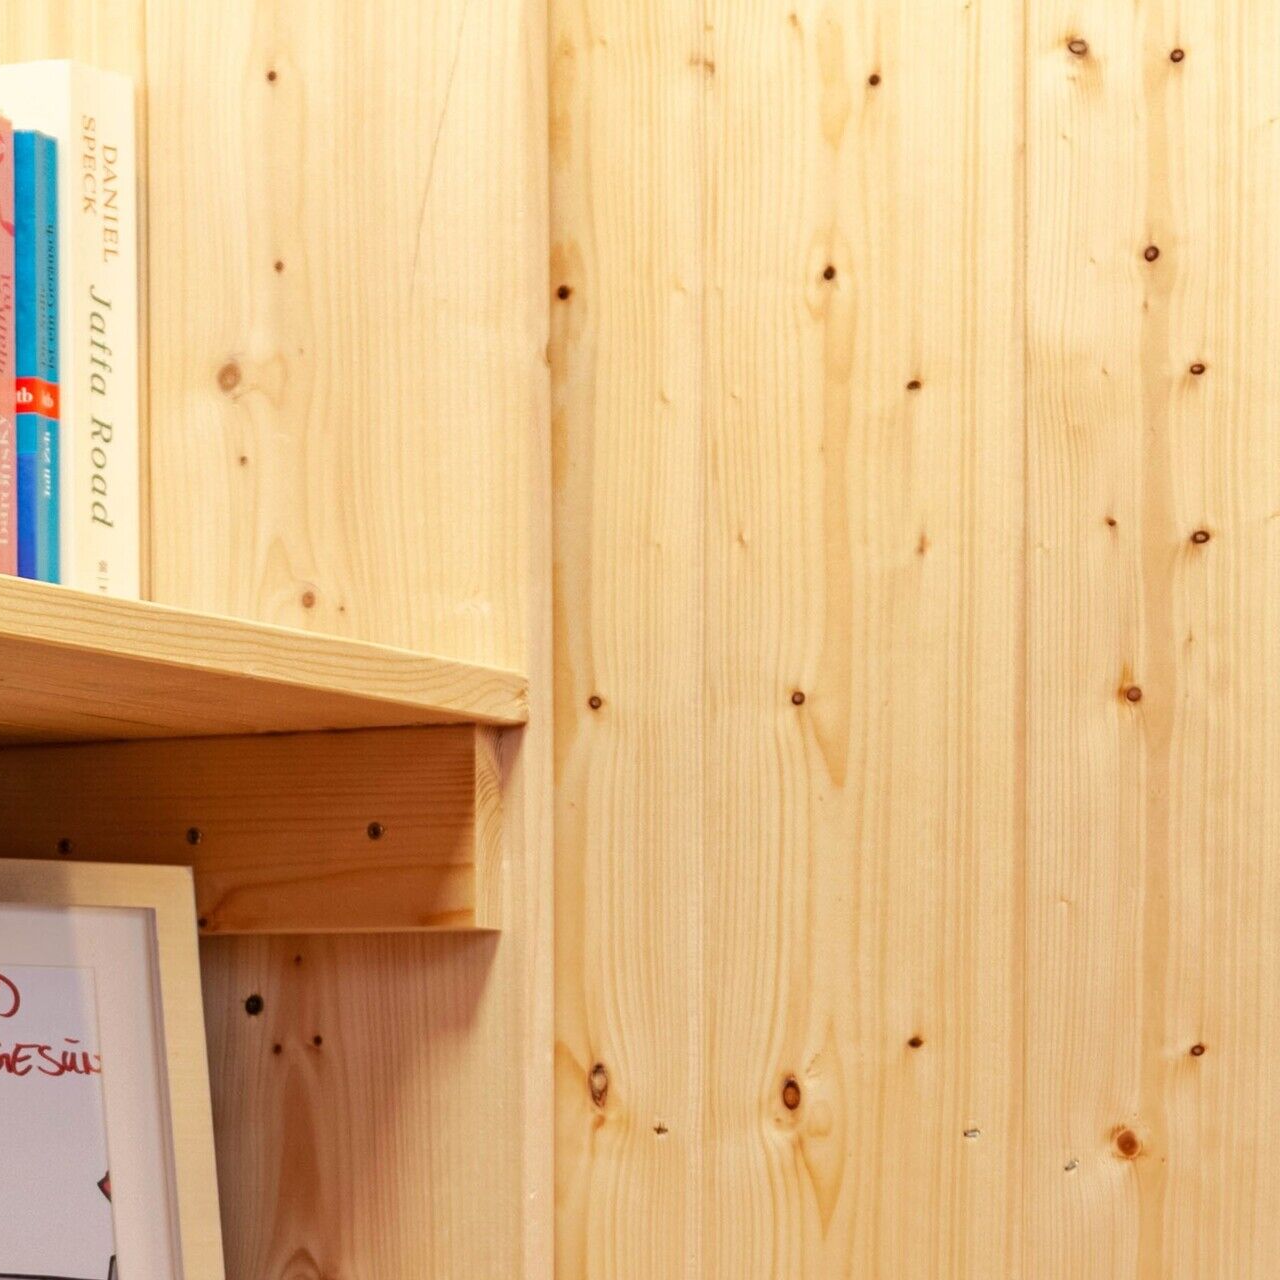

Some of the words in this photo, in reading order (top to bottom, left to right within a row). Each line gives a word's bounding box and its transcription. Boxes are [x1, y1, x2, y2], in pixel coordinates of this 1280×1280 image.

[82, 114, 97, 217] SPECK
[102, 144, 119, 264] DANIEL
[89, 283, 113, 397] Jaffa
[90, 416, 114, 528] Road
